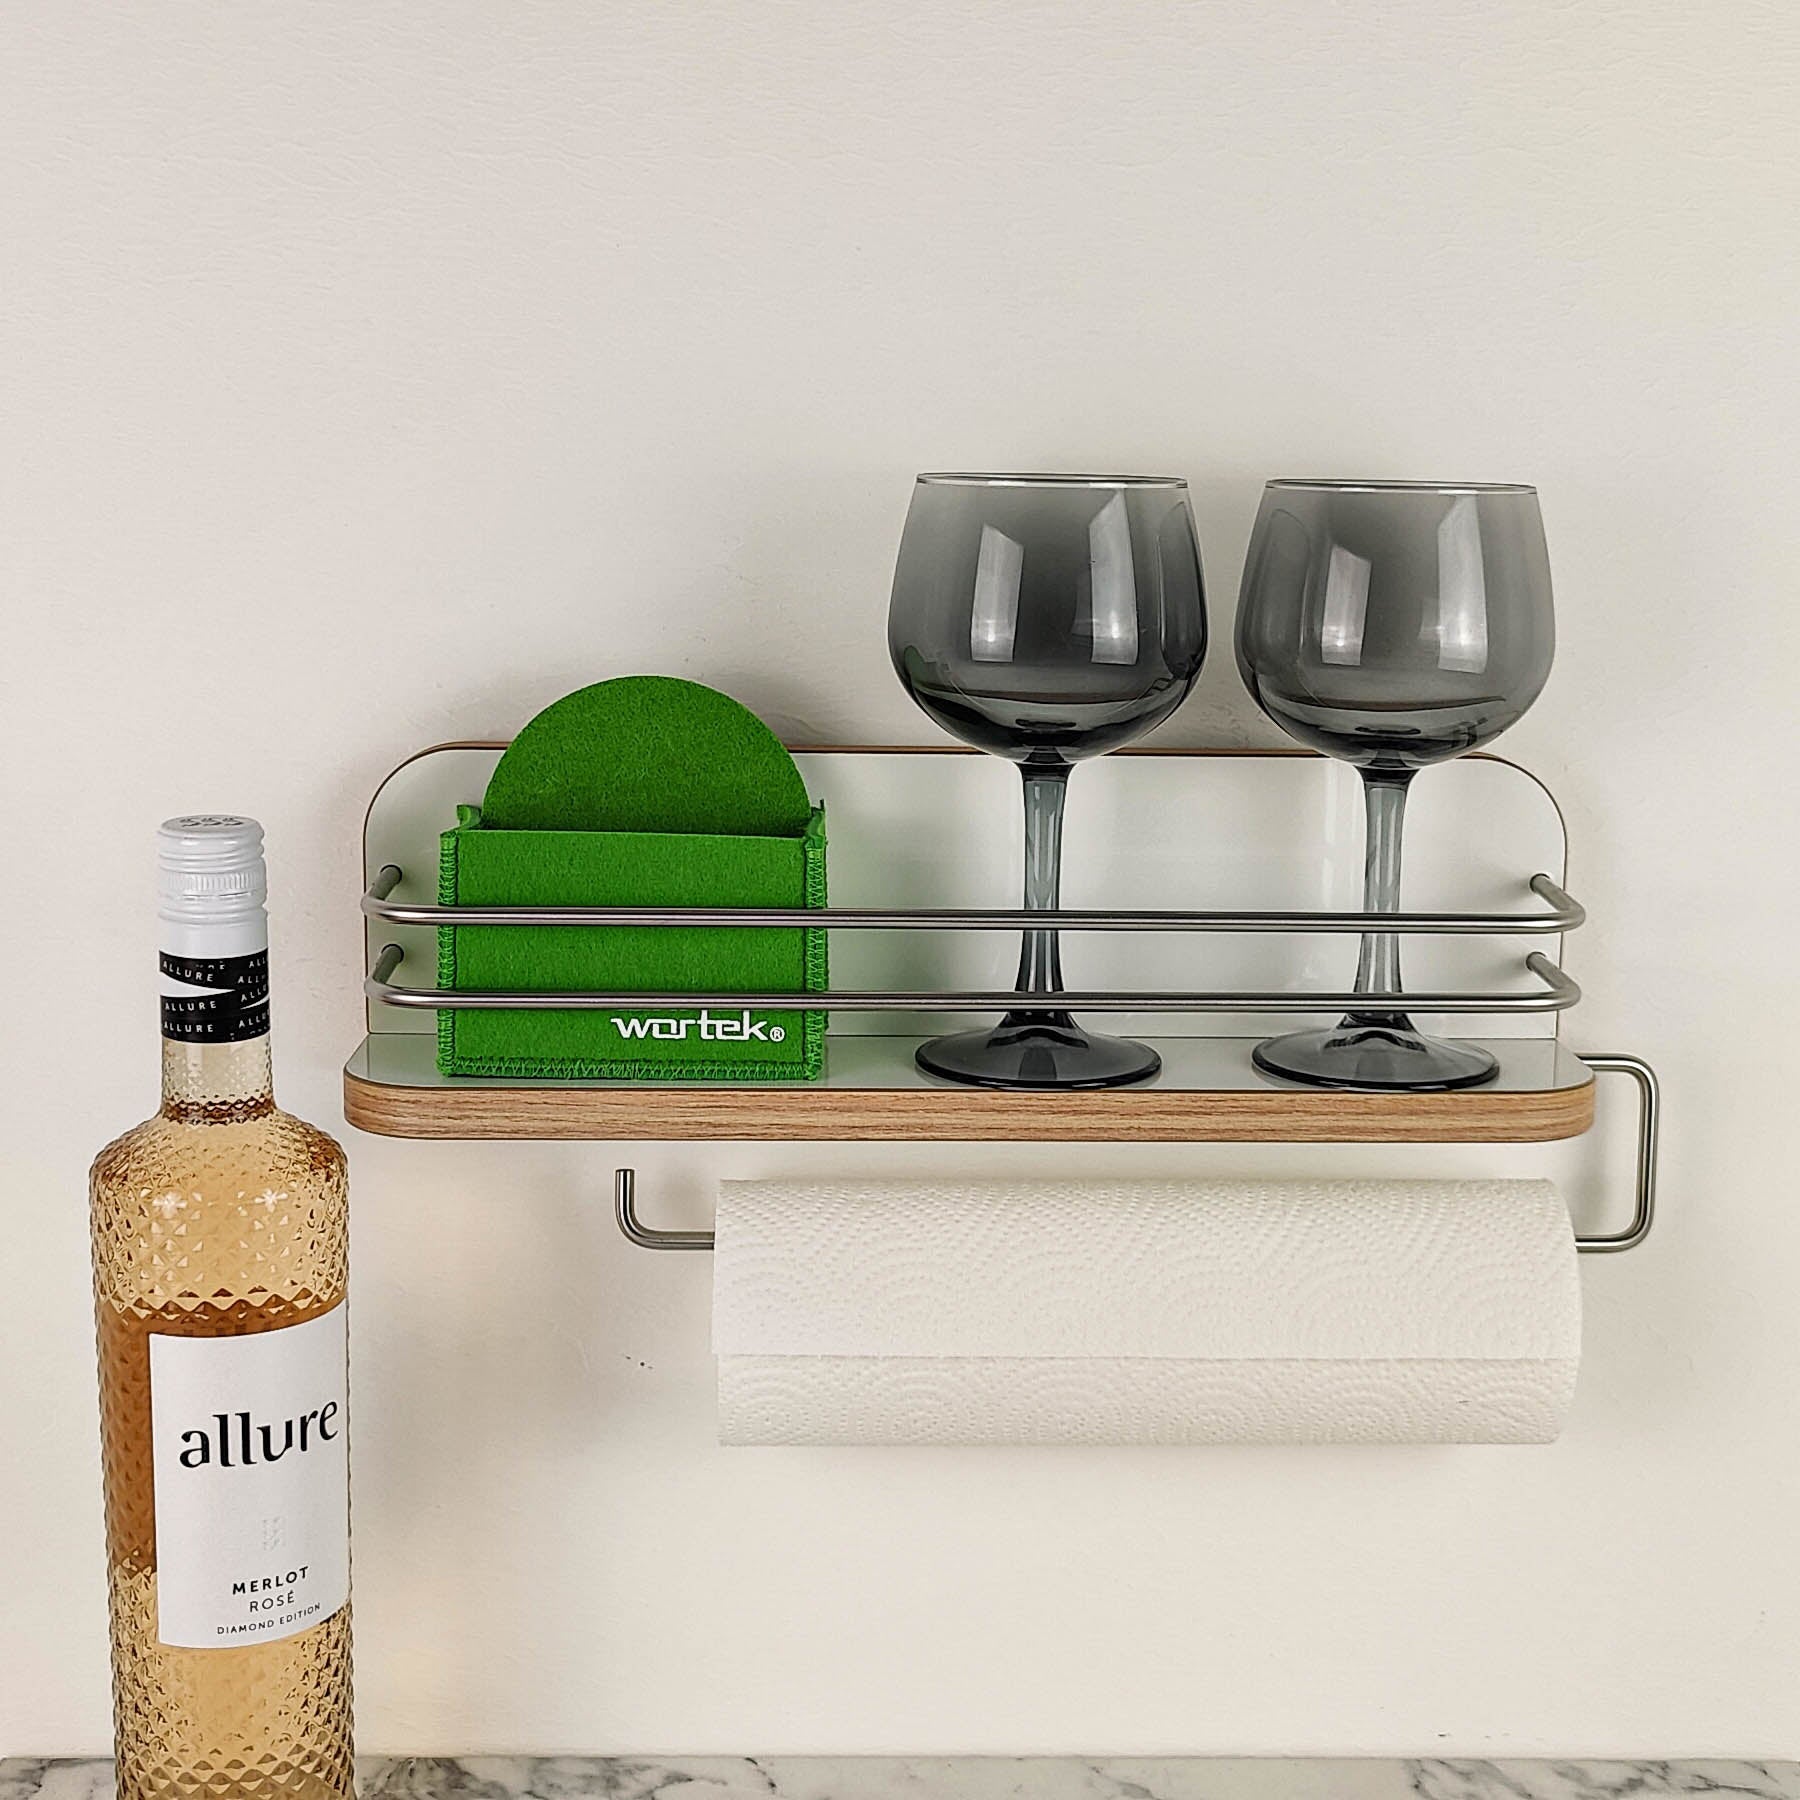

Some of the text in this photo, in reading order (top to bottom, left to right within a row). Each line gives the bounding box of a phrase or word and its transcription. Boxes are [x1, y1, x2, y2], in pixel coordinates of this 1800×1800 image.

[162, 961, 214, 982] ALLURE
[165, 1001, 217, 1012] ALLURE
[163, 1021, 214, 1032] ALLURE
[180, 1401, 339, 1468] allure
[232, 1566, 310, 1595] MERLOT
[249, 1590, 295, 1613] ROSÉ
[217, 1603, 321, 1636] DIAMOND EDITION
